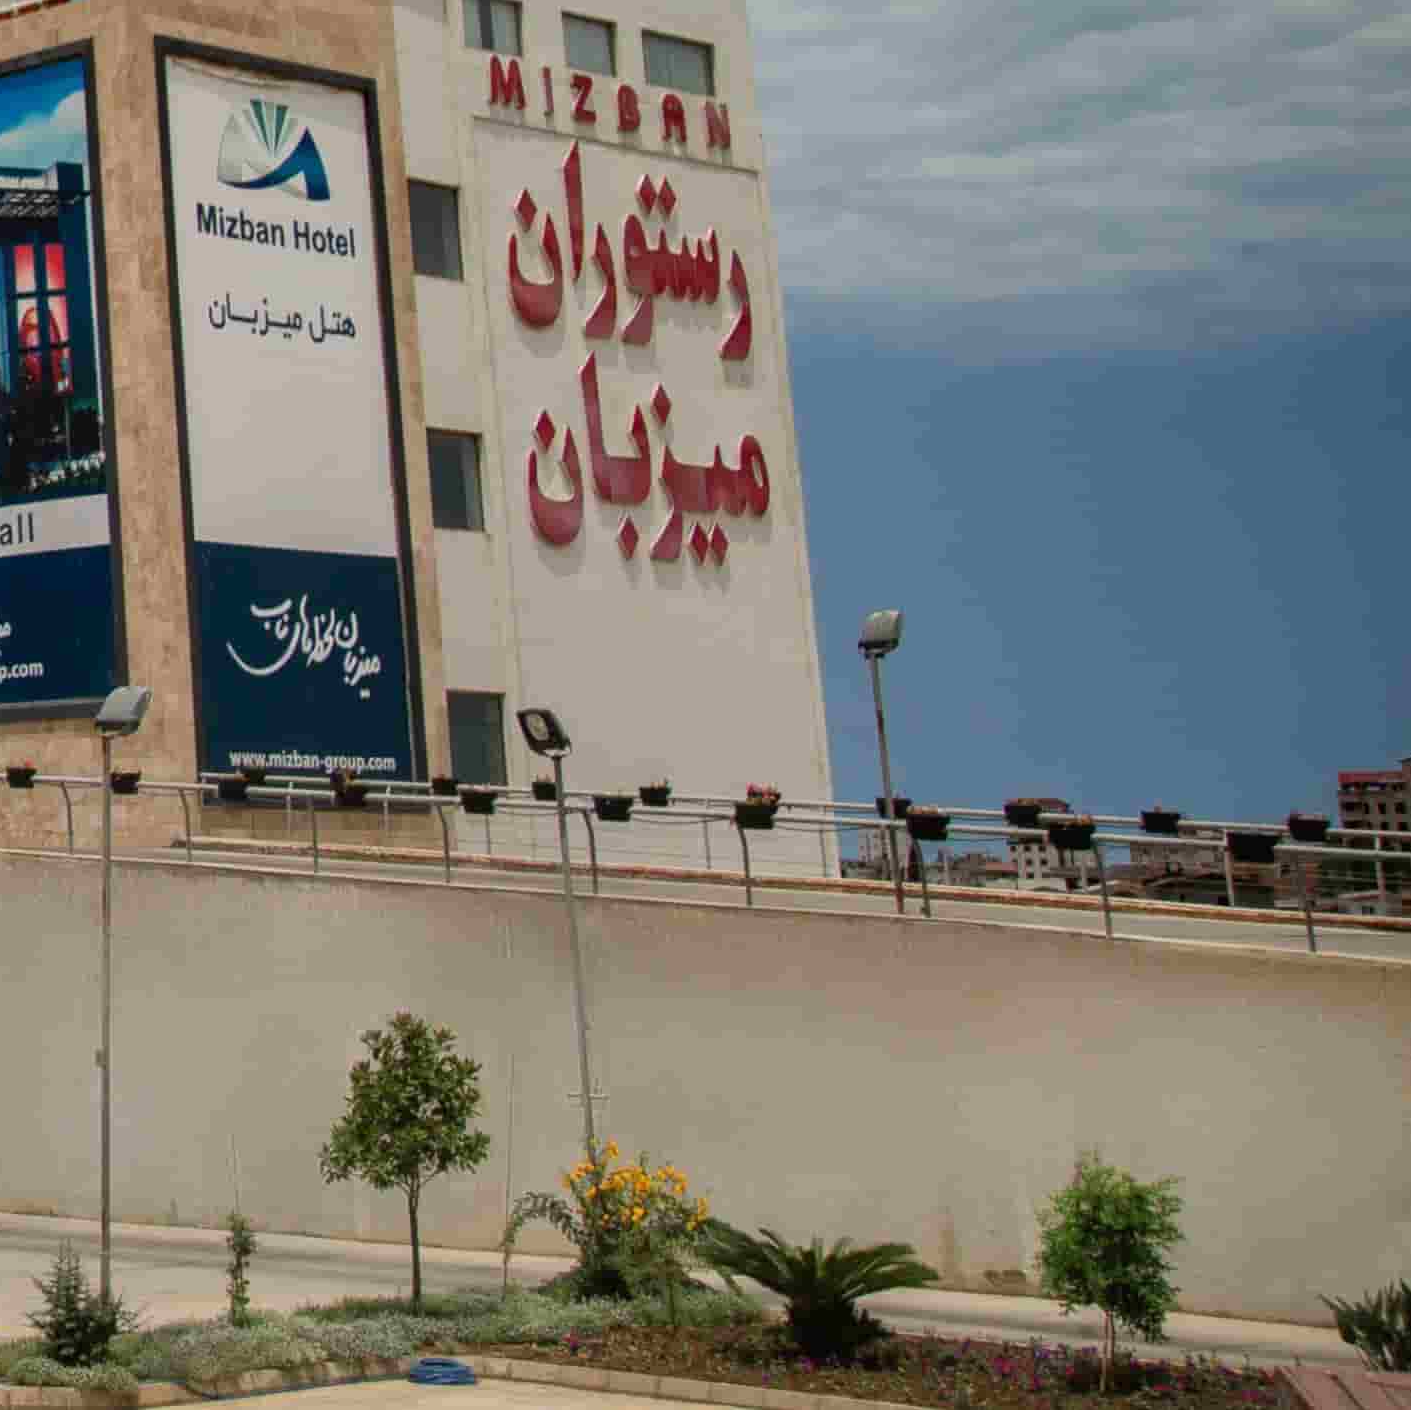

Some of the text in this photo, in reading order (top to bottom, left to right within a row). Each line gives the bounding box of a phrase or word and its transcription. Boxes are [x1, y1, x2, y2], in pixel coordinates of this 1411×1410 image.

[488, 54, 732, 151] MIZBAN
[196, 202, 356, 258] Mizban Hotel
[508, 140, 754, 362] رستوران
[209, 292, 356, 343] هتل میزبان
[527, 350, 771, 568] میزبان
[229, 750, 397, 775] www.mizban-group.com
